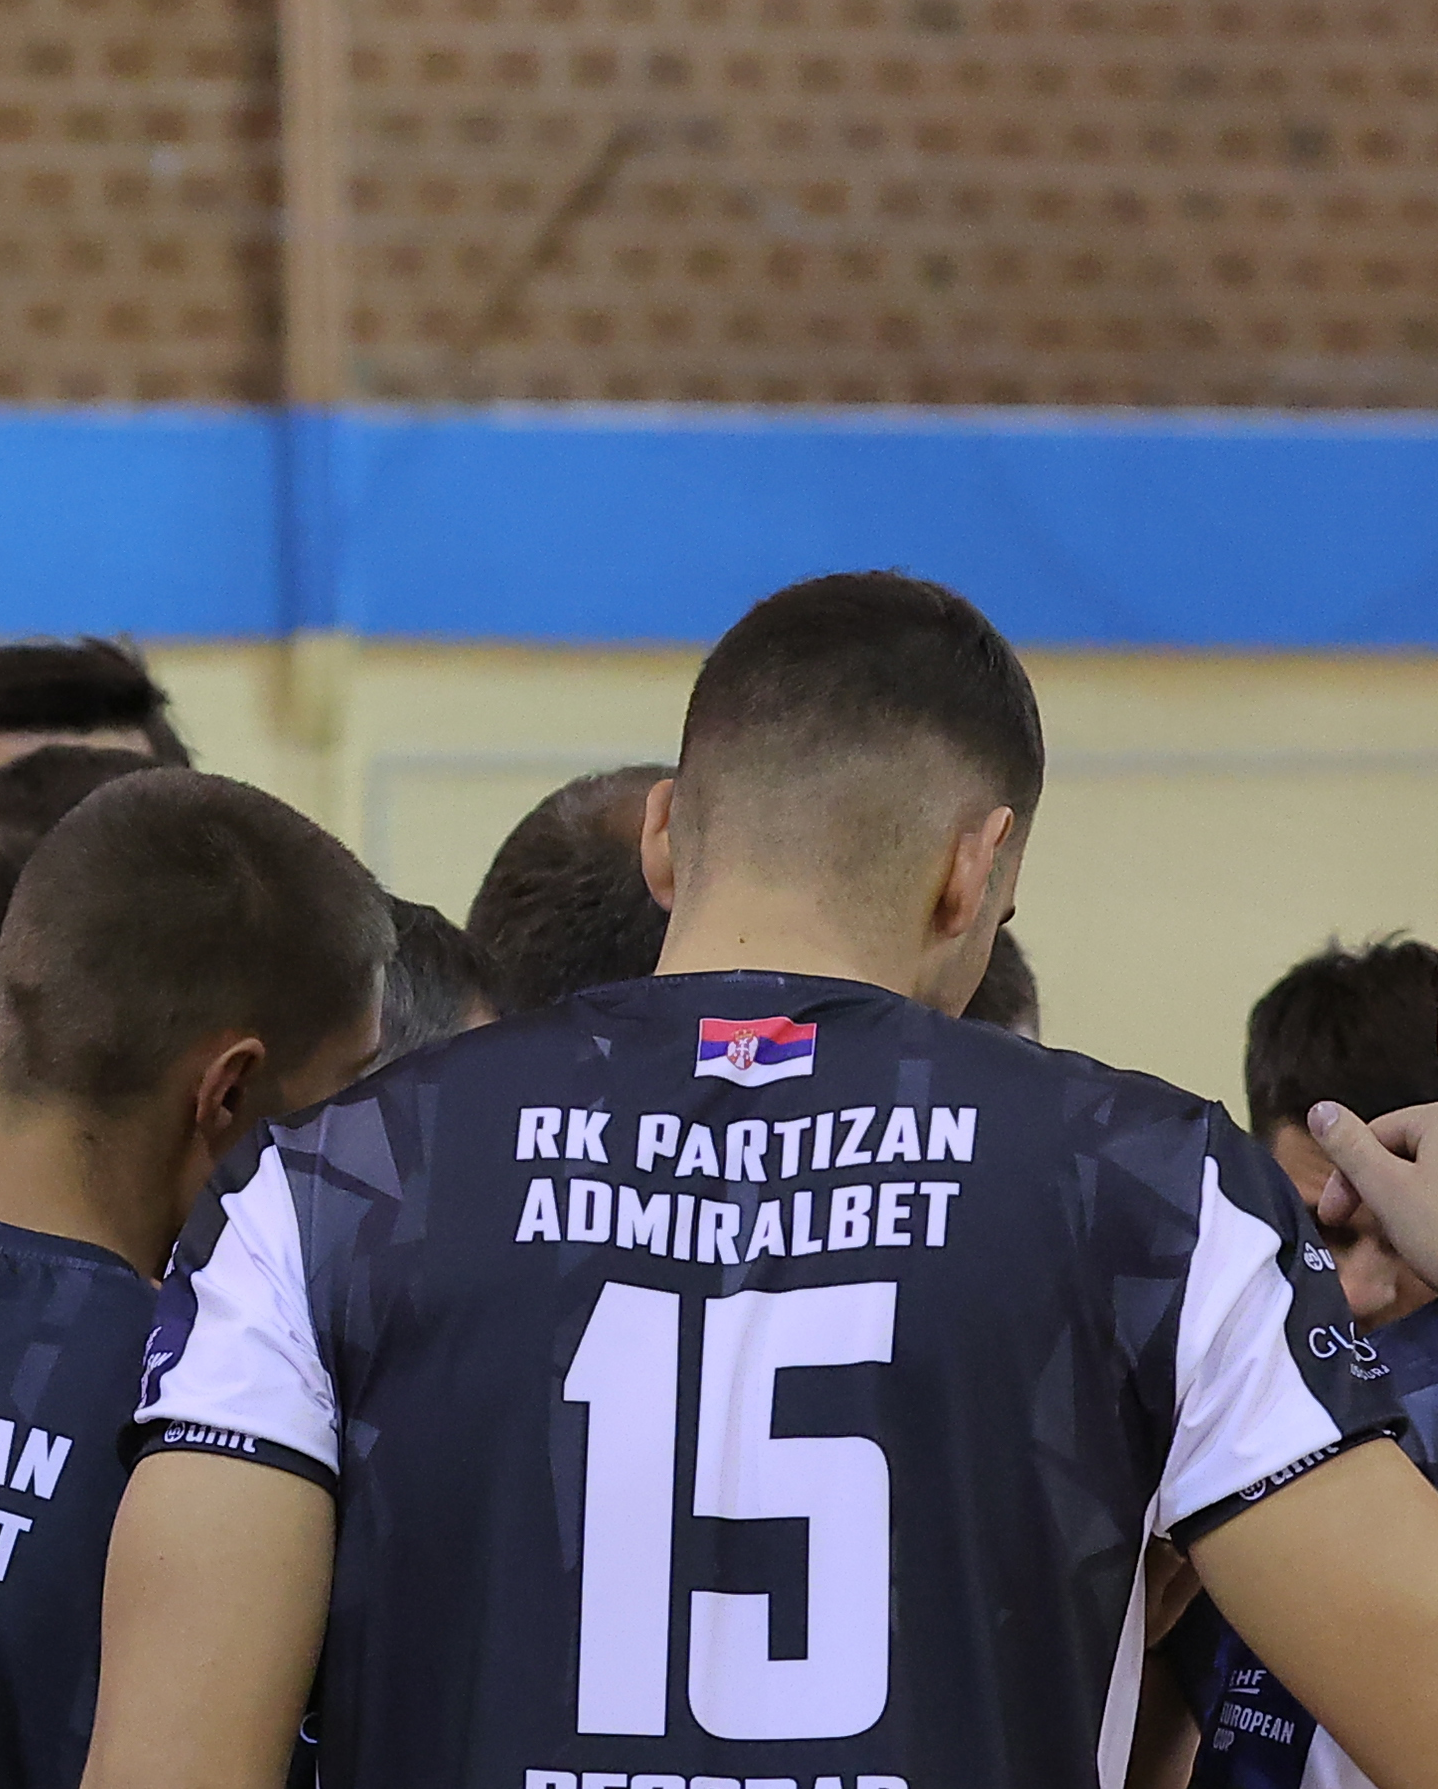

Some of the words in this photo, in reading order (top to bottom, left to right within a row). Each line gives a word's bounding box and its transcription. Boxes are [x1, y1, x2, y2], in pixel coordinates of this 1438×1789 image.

[515, 1107, 612, 1164] RK
[636, 1106, 977, 1182] PARTIZAN
[515, 1178, 960, 1264] ADMIRALBET
[563, 1280, 898, 1741] 15
